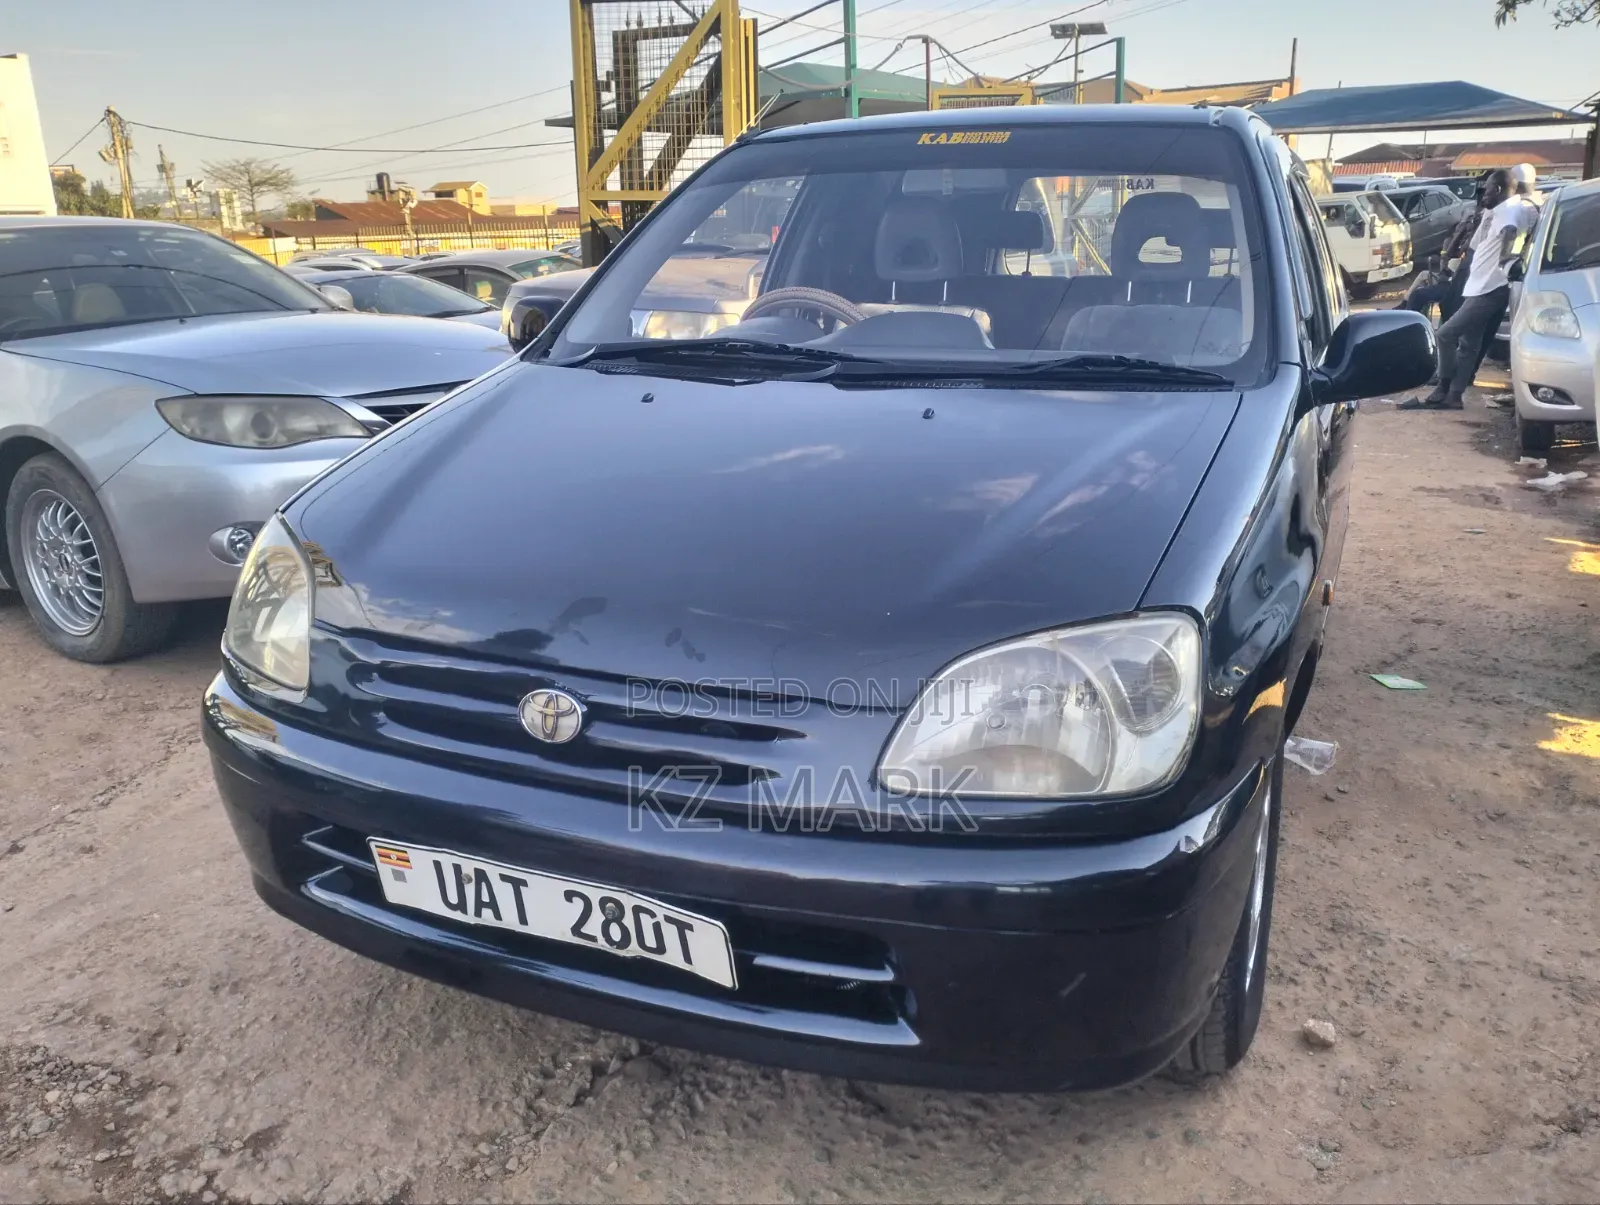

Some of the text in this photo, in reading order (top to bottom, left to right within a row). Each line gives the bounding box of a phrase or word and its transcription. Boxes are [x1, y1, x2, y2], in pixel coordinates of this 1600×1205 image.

[917, 132, 965, 145] KAB
[433, 859, 695, 966] UAT 280T
